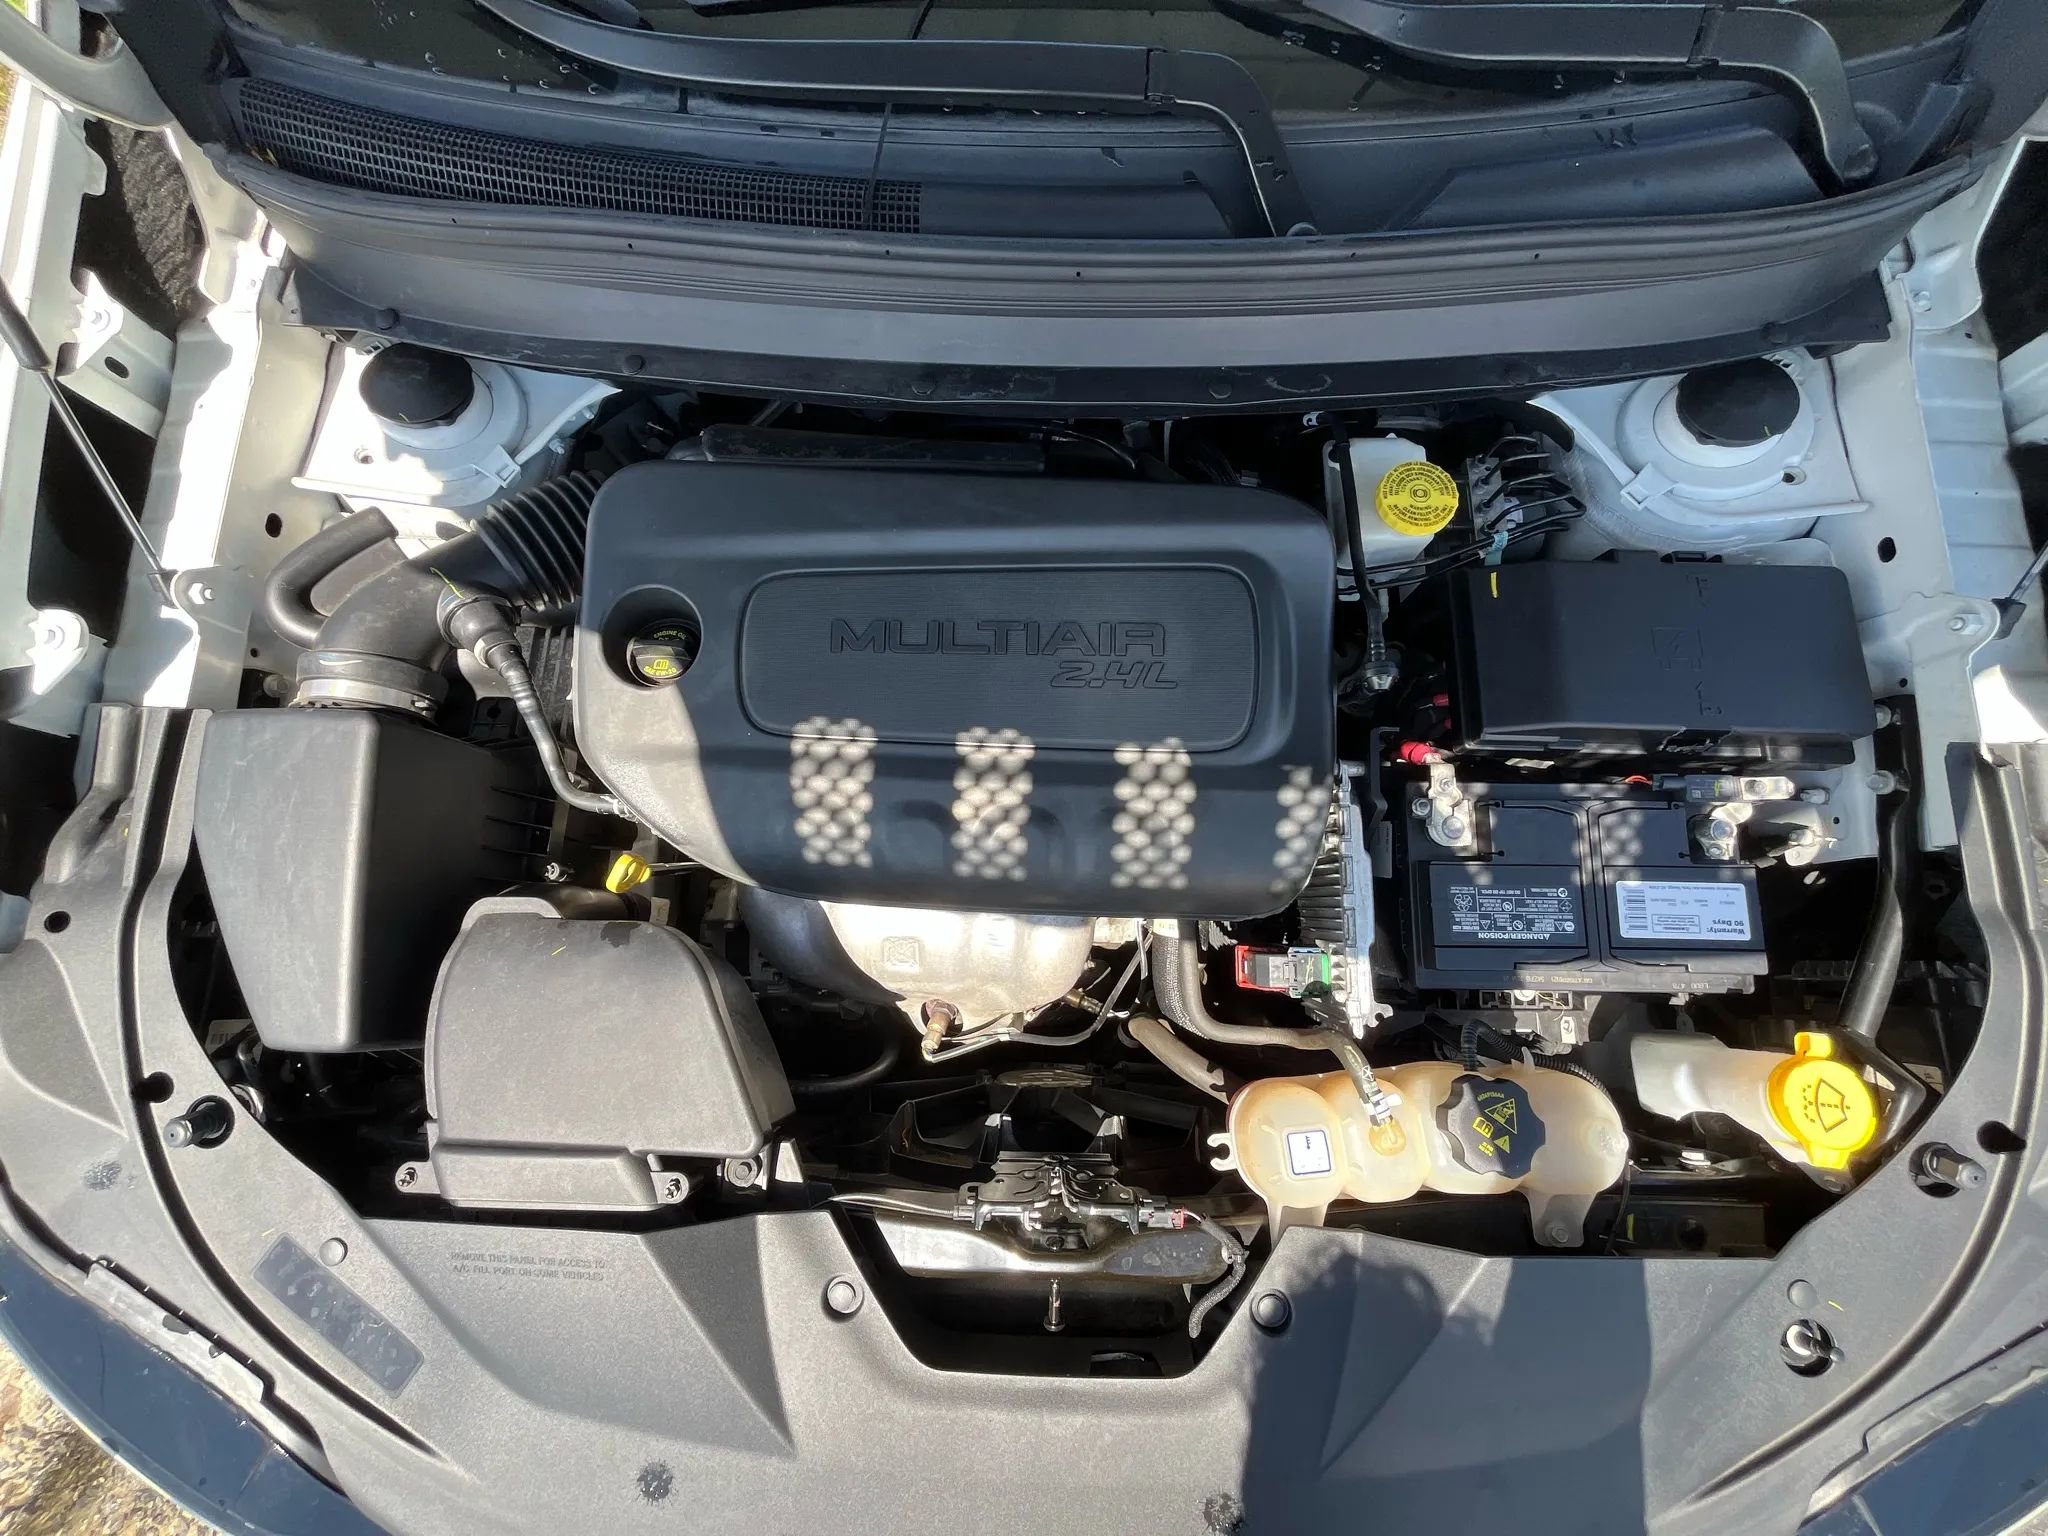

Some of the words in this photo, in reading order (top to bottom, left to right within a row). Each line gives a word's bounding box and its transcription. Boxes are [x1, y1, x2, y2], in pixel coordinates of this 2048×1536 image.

[654, 630, 678, 638] ENGINE
[830, 618, 1167, 657] MULTIAIR
[1050, 661, 1179, 690] 2.4L
[1706, 927, 1745, 935] Warranty:
[450, 1252, 488, 1262] REMOVE
[488, 1253, 507, 1263] THIS
[510, 1255, 537, 1265] PANEL
[539, 1256, 556, 1266] FOR
[558, 1258, 592, 1268] ACCESS
[452, 1264, 470, 1274] A/C
[473, 1265, 490, 1274] FILL
[493, 1266, 516, 1276] PORT
[518, 1268, 532, 1277] ON
[534, 1268, 559, 1279] SOME
[562, 1270, 604, 1281] VEHICLES
